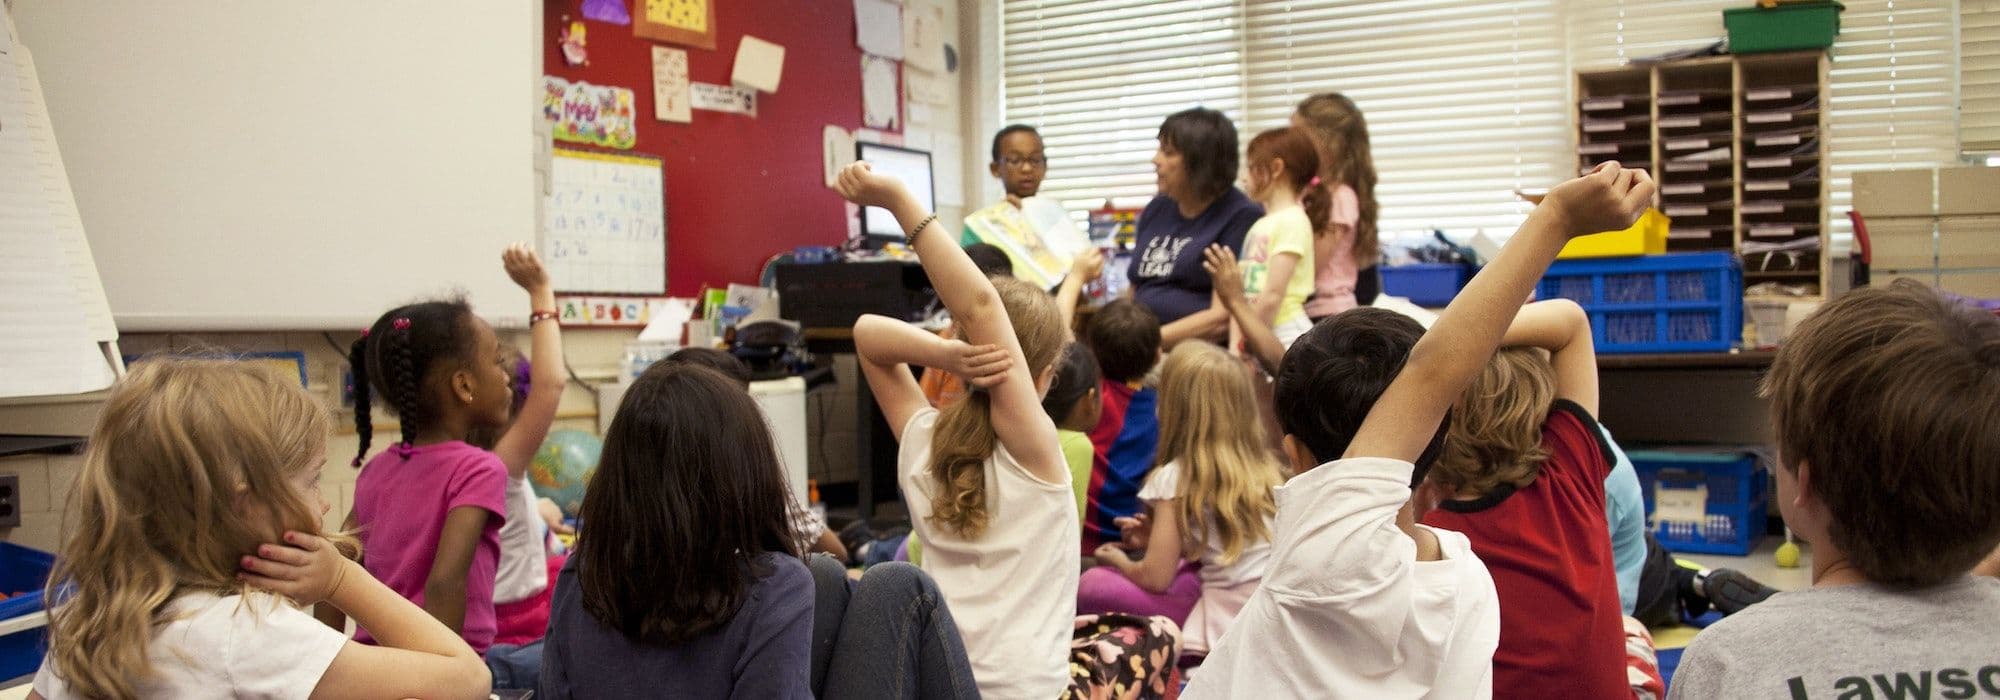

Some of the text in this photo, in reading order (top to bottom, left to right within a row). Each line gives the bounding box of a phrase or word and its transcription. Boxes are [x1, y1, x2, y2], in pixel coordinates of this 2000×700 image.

[563, 303, 638, 320] A B C
